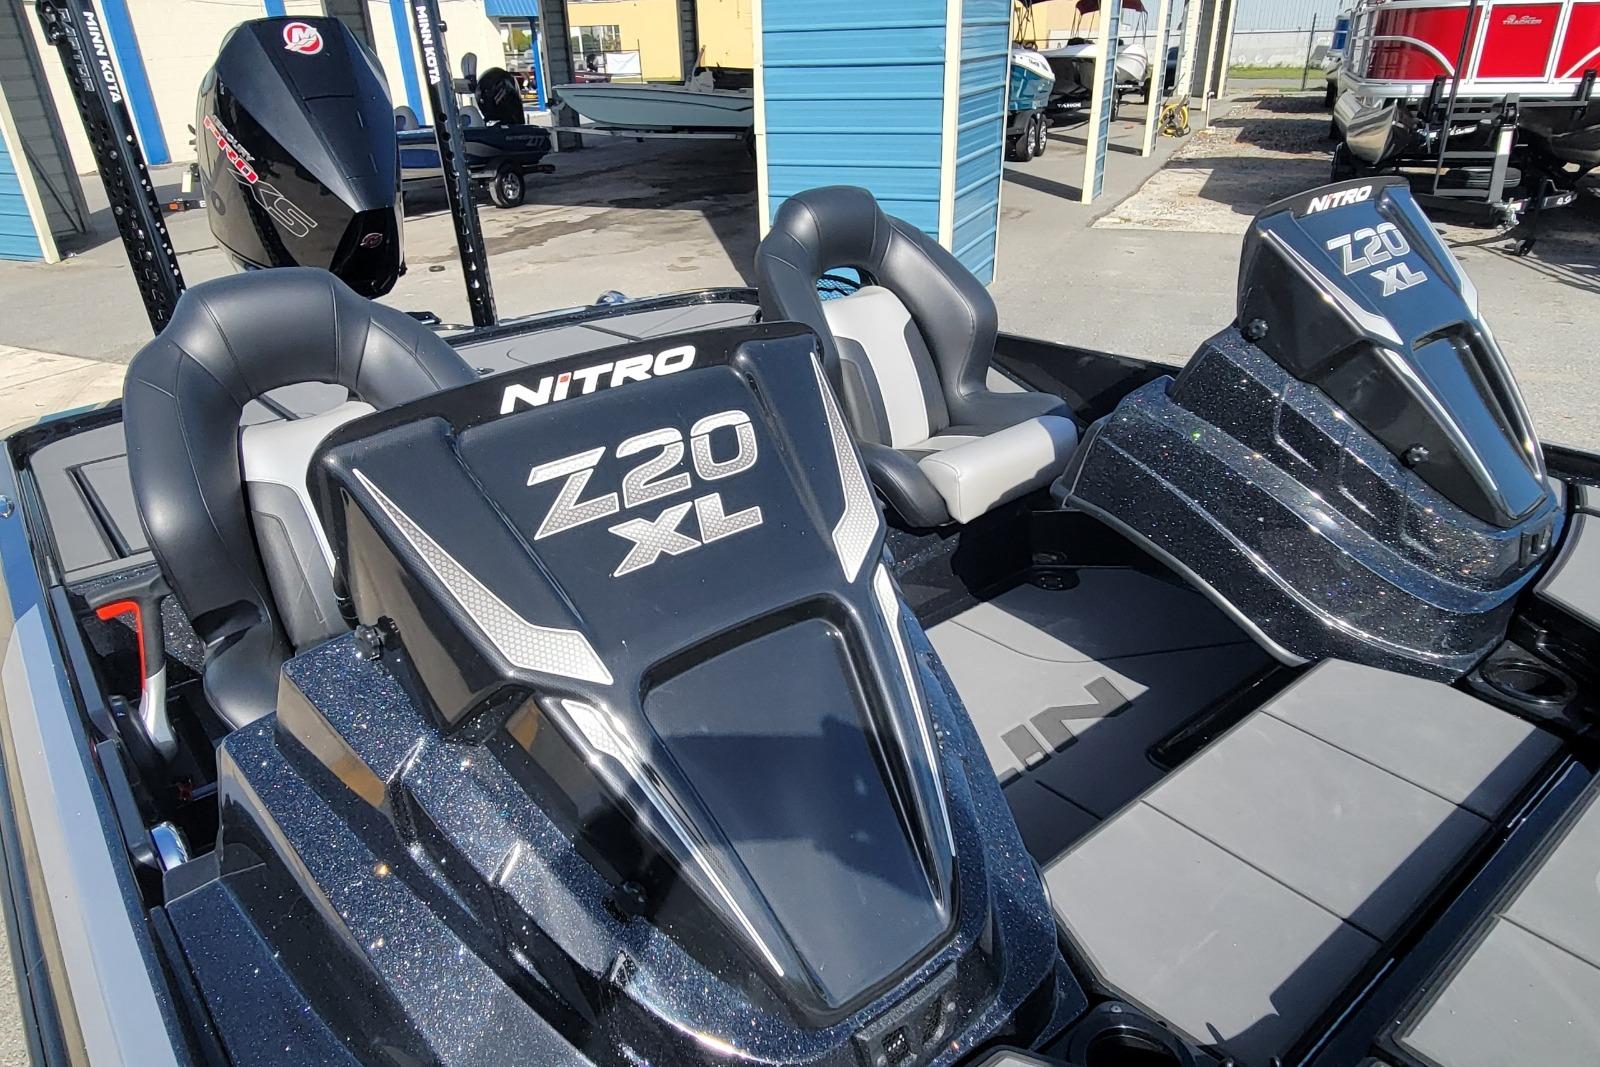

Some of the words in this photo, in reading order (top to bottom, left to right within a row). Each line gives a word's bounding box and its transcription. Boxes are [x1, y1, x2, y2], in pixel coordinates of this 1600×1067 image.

[57, 8, 95, 92] RAPTOR
[82, 11, 108, 57] MINN
[99, 60, 122, 103] KOTA
[415, 6, 433, 45] MINN
[424, 47, 441, 85] KOTA
[203, 115, 259, 184] PRO
[1306, 185, 1373, 215] NITRO
[1326, 221, 1411, 276] Z20
[1369, 261, 1428, 297] XL
[500, 345, 696, 415] NITRO
[526, 409, 758, 541] Z20
[607, 492, 763, 577] XL
